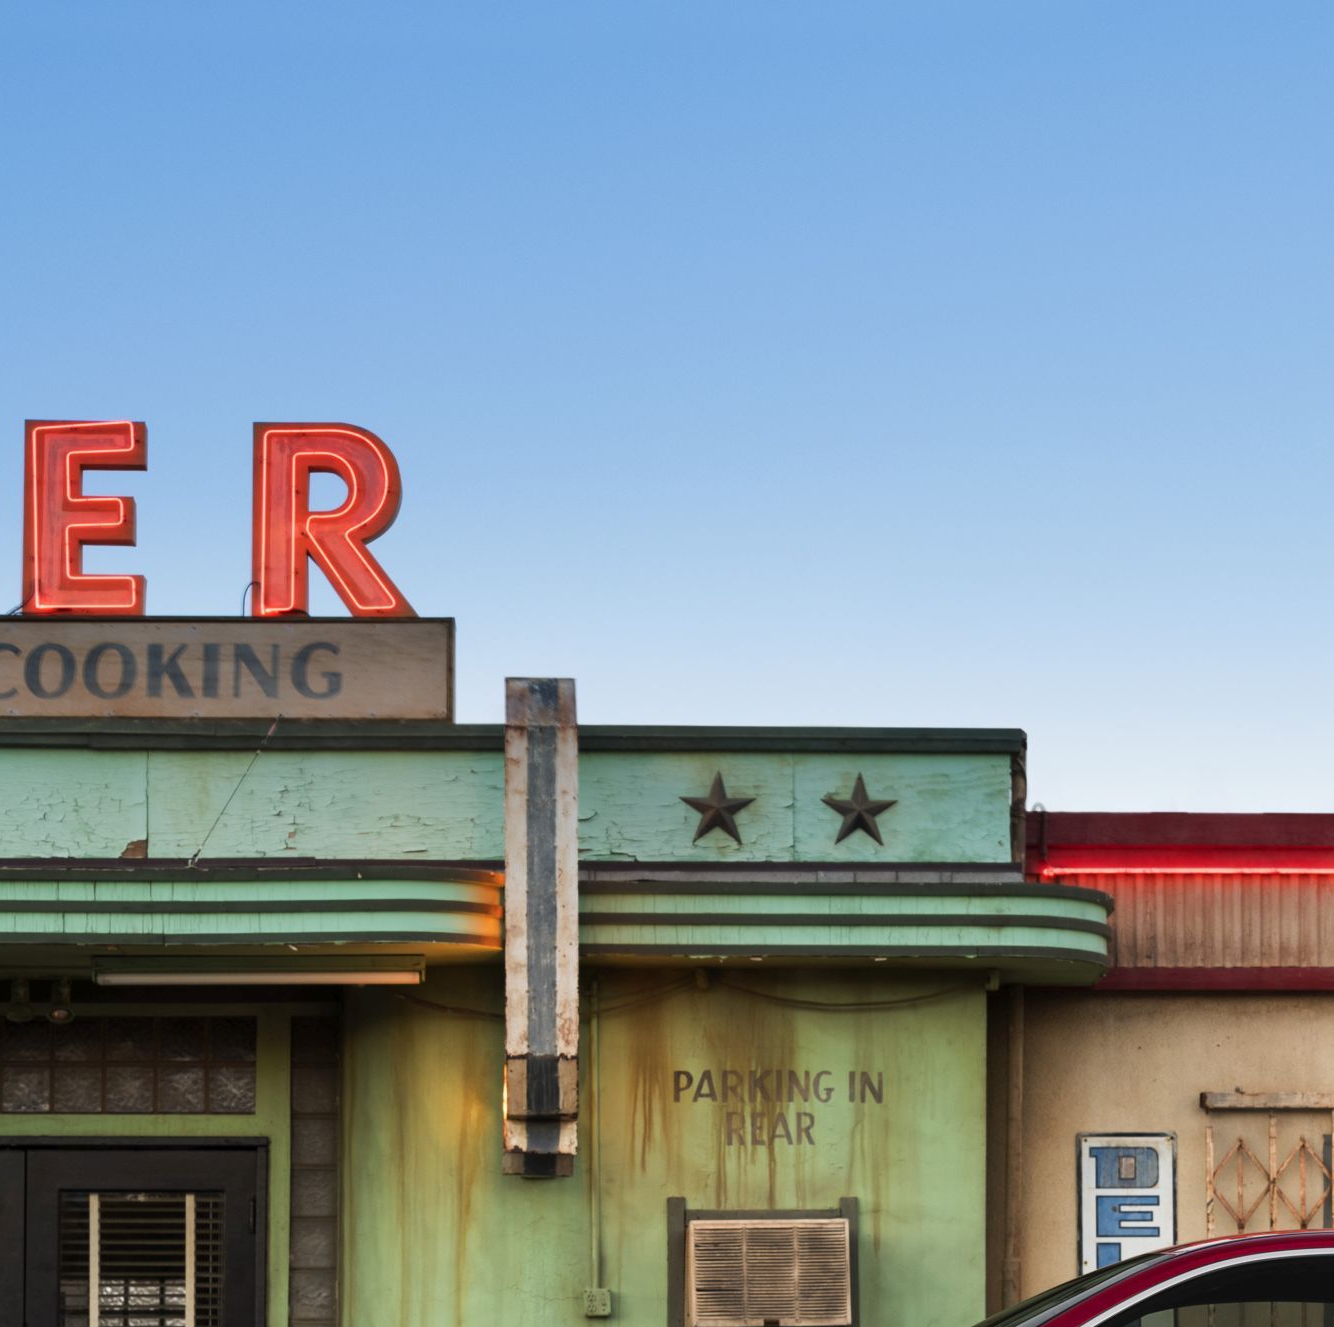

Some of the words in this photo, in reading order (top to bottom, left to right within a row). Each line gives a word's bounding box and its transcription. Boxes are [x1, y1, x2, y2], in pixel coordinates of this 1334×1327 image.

[672, 1069, 835, 1104] PARKING
[848, 1071, 884, 1105] IN
[725, 1111, 816, 1147] REAR
